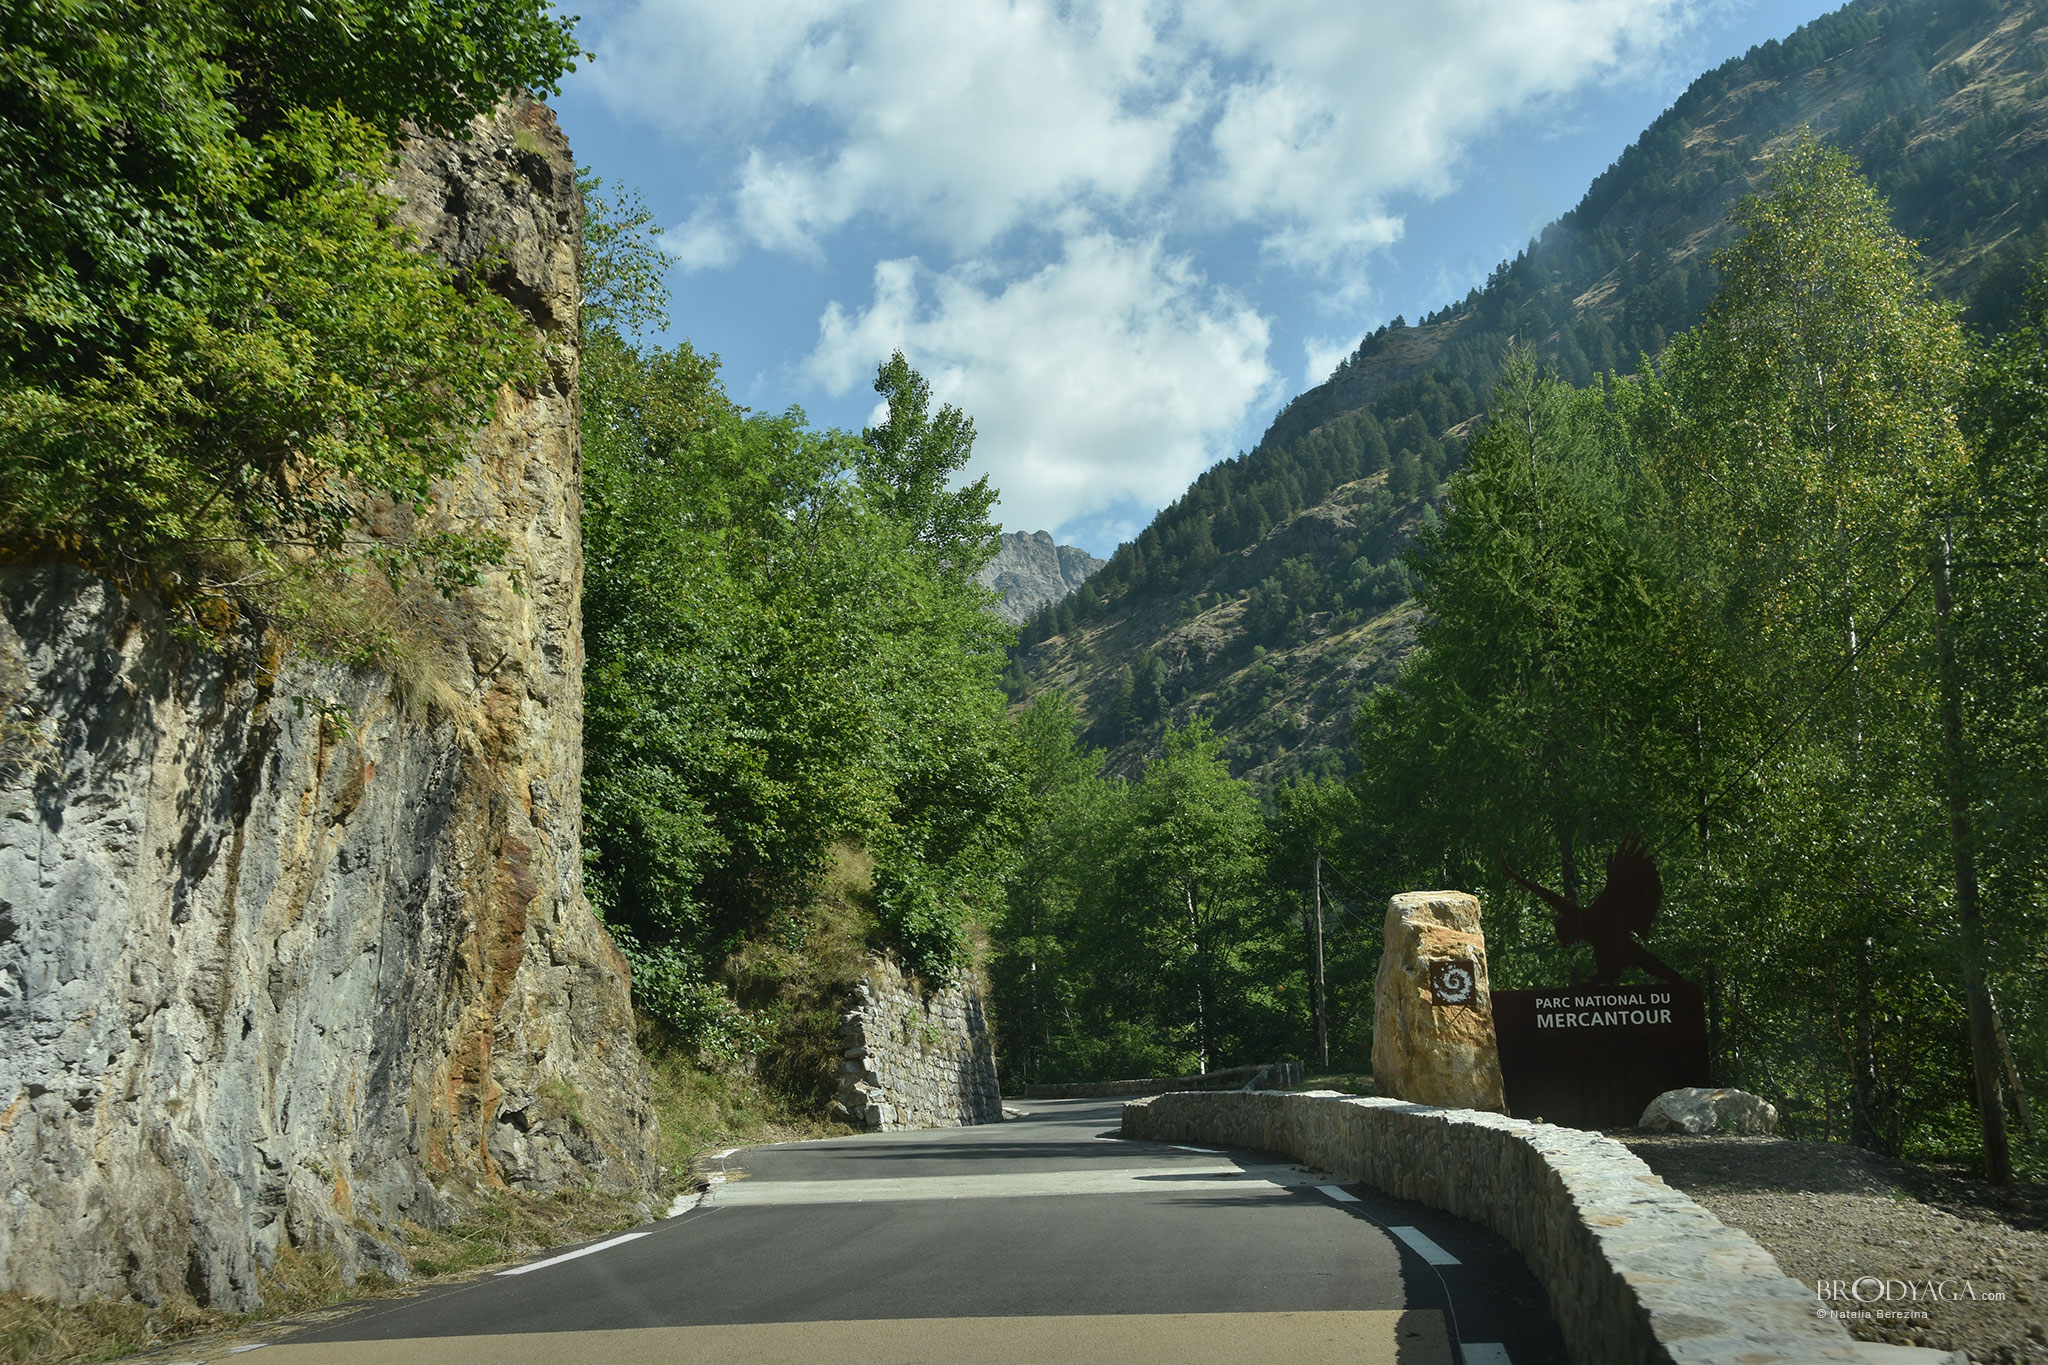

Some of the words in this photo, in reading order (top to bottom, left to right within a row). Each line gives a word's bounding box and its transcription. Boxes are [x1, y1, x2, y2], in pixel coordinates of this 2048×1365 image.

[1535, 997, 1571, 1009] PARC
[1575, 994, 1646, 1008] NATIONAL
[1650, 993, 1671, 1004] DU
[1536, 1009, 1672, 1029] MERCANTOUR
